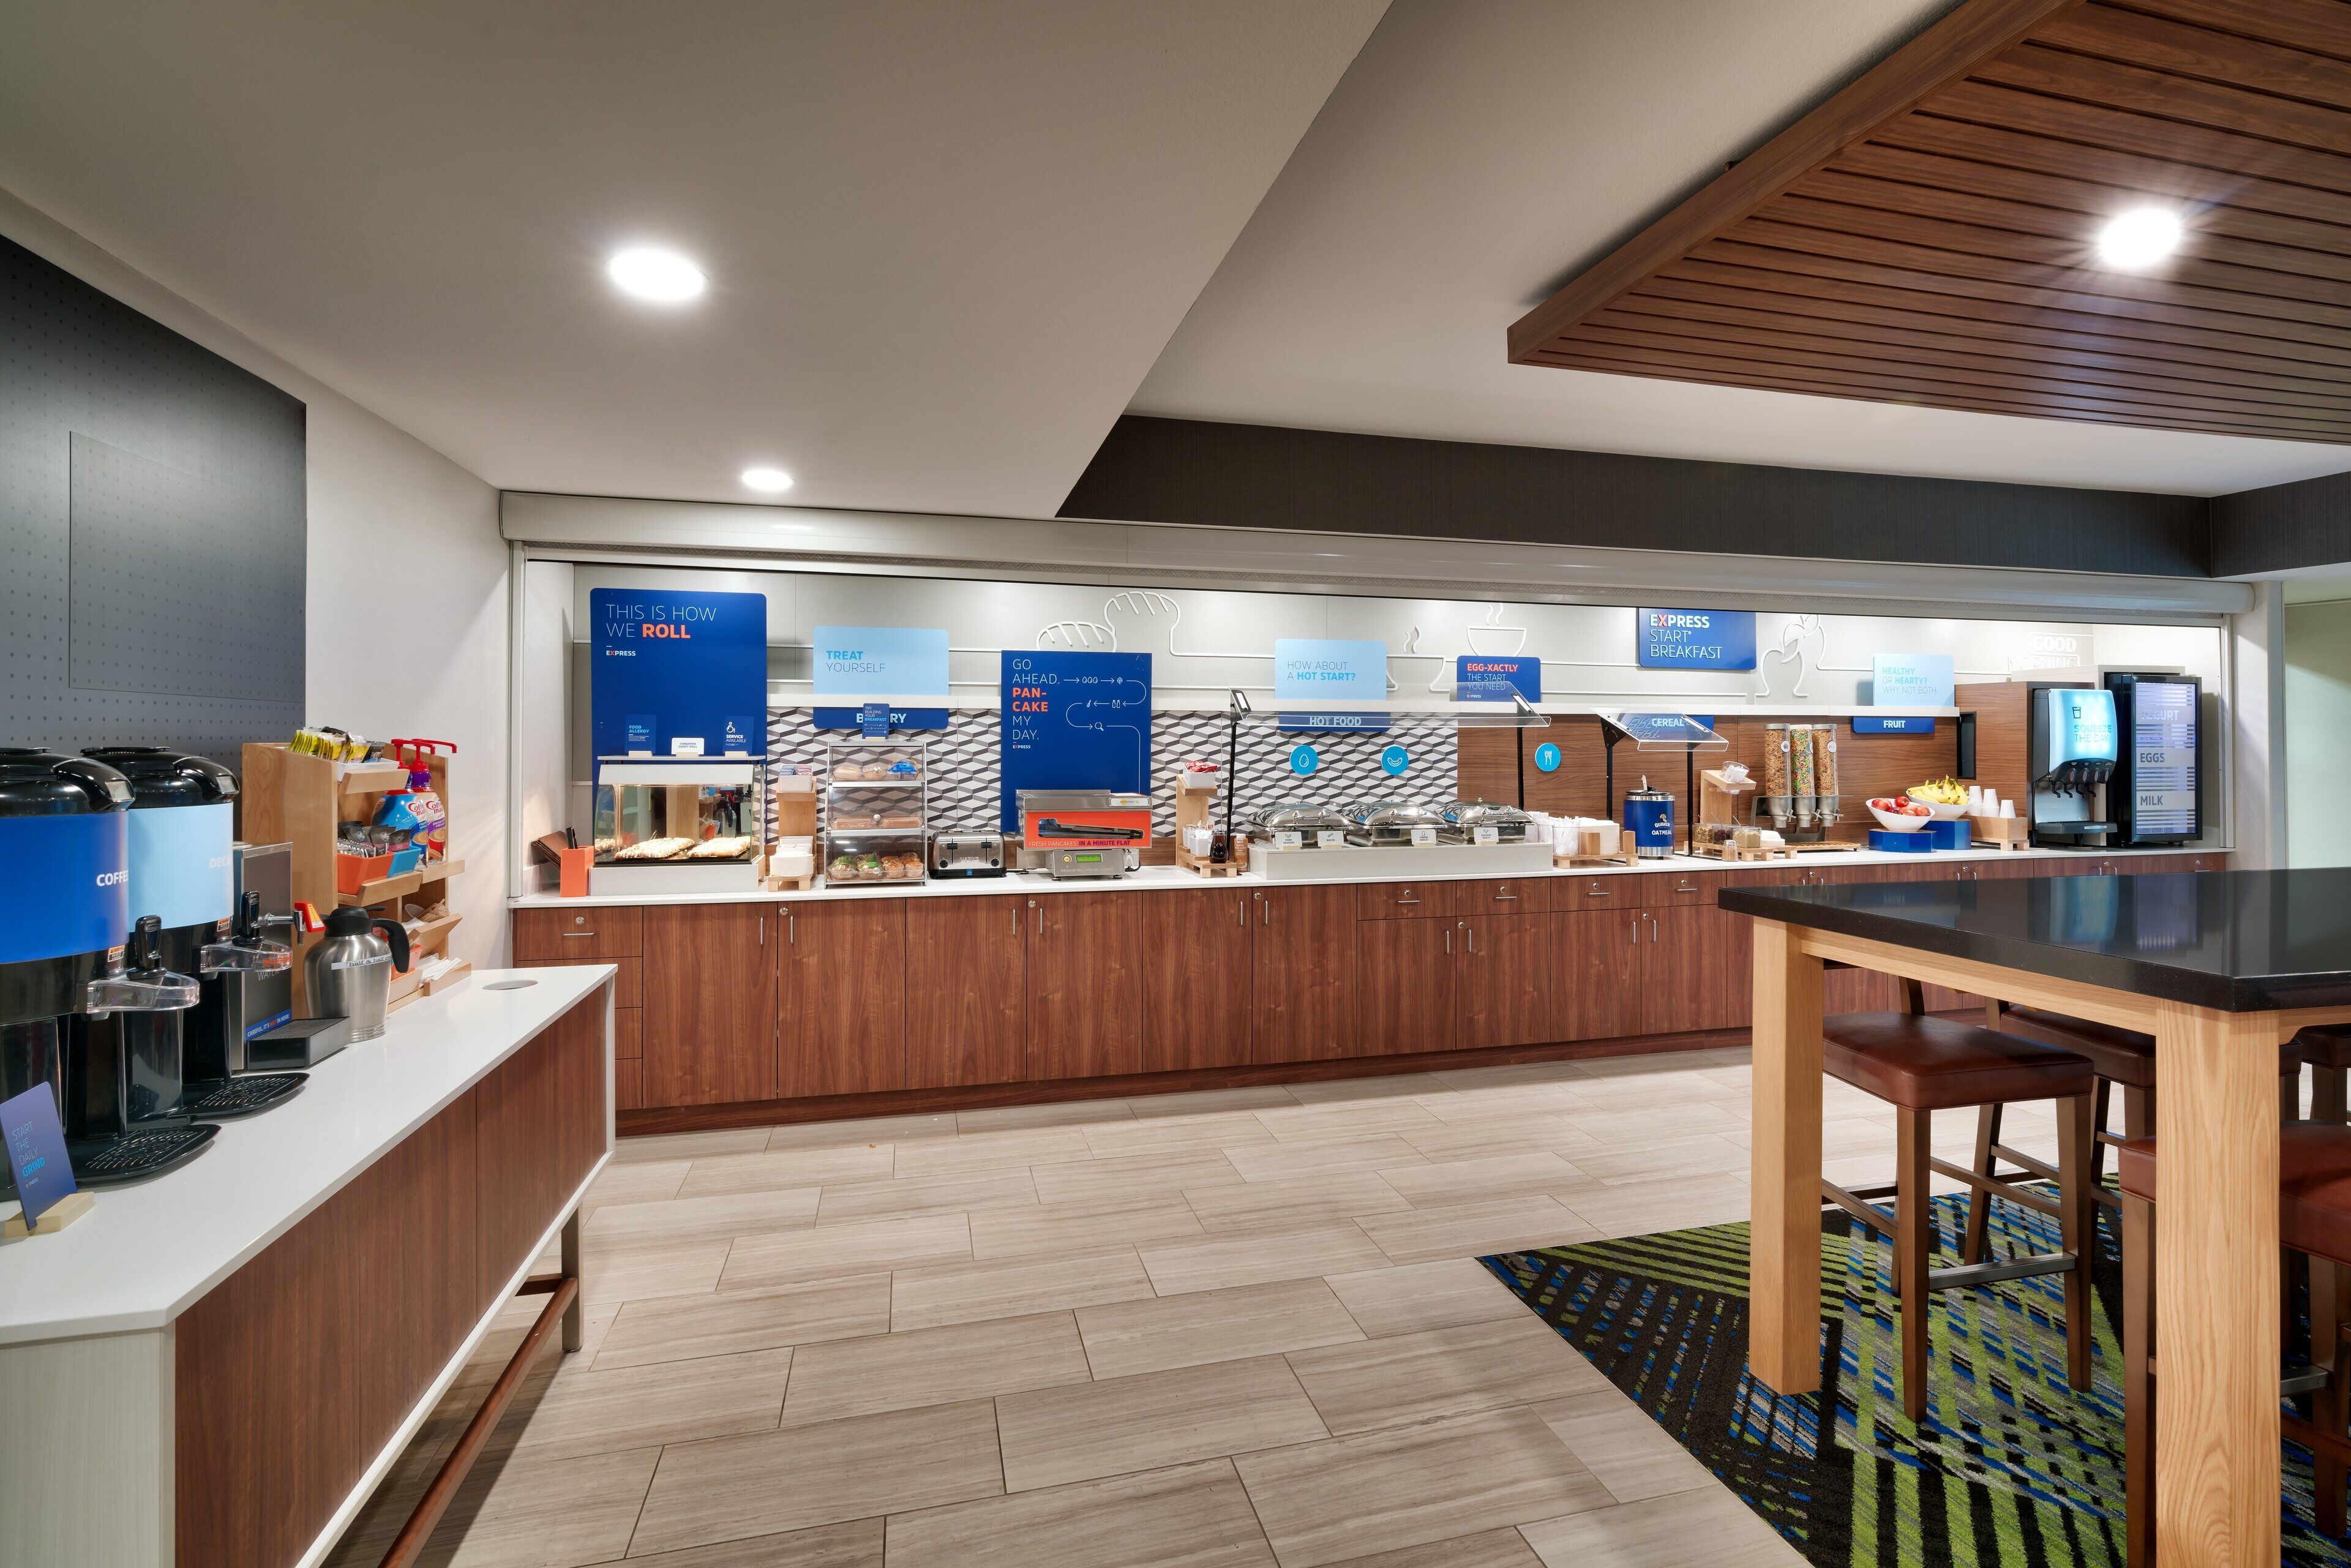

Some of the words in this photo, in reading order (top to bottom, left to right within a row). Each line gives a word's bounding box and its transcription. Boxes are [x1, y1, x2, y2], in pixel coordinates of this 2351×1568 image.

[606, 604, 644, 620] THIS
[652, 606, 666, 620] IS
[673, 606, 716, 621] HOW
[1650, 614, 1710, 629] EXPRESS
[606, 623, 635, 637] WE
[642, 623, 691, 639] ROLL
[2033, 636, 2077, 653] GOOD
[826, 650, 863, 660] TREAT
[1651, 644, 1722, 659] BREAKFAST
[826, 662, 886, 673] YOURSELF
[1013, 659, 1032, 670] GO
[1287, 661, 1312, 670] HOW
[1314, 661, 1348, 670] ABOUT
[1467, 663, 1518, 672] EGG-XACTLY
[1012, 673, 1060, 685] AHEAD.
[1287, 672, 1294, 680] A
[1297, 672, 1317, 680] HOT
[1320, 672, 1356, 681] START?
[1468, 673, 1482, 681] THE
[1883, 676, 1892, 685] OR
[1013, 688, 1047, 698] PAN-
[1013, 701, 1048, 712] CAKE
[1013, 716, 1031, 726] MY
[1310, 716, 1332, 726] HOT
[1333, 716, 1362, 726] FOOD
[1652, 718, 1685, 727] CEREAL
[1883, 720, 1906, 729] FRUIT
[2074, 724, 2112, 733] SQUEEZE
[1013, 729, 1039, 740] DAY.
[2140, 752, 2165, 763] EGGS
[2140, 795, 2163, 806] MILK
[12, 1121, 34, 1141] START
[15, 1137, 31, 1152] THE
[19, 1146, 39, 1166] DAILY
[22, 1157, 46, 1177] GRIND
